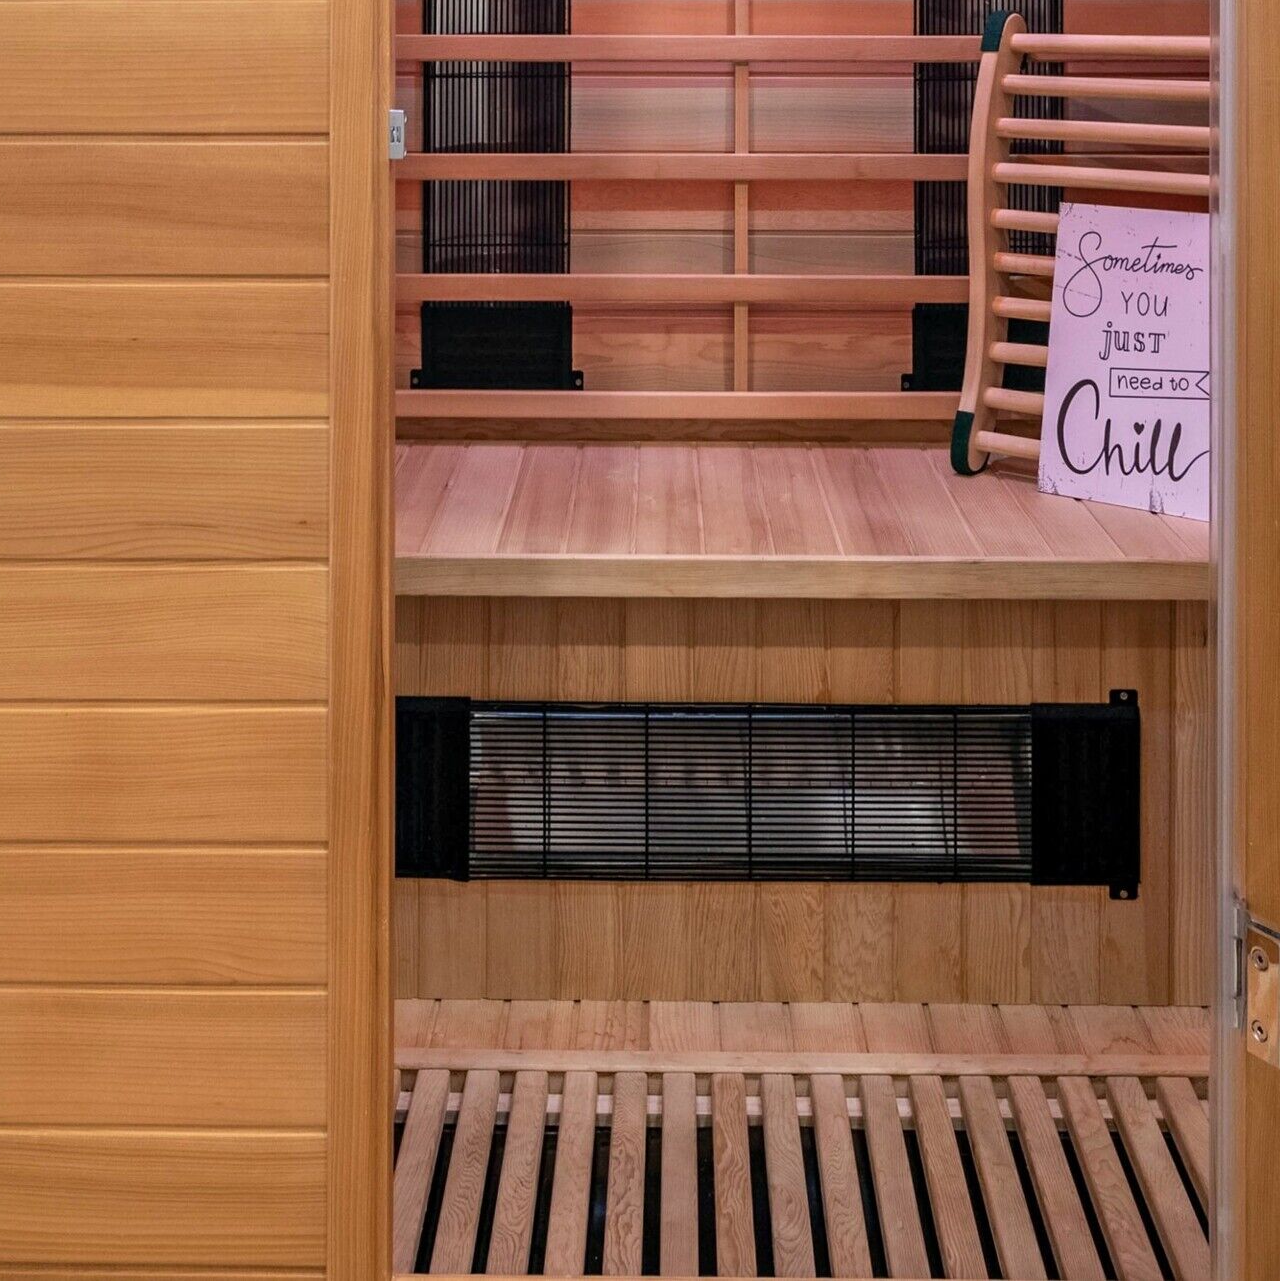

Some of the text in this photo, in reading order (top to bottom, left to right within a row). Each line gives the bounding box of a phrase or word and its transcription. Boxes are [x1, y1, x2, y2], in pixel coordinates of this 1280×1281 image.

[1063, 231, 1204, 317] Sometimes
[1121, 290, 1168, 317] YOU
[1117, 374, 1190, 392] need to
[1056, 379, 1211, 482] Chill
